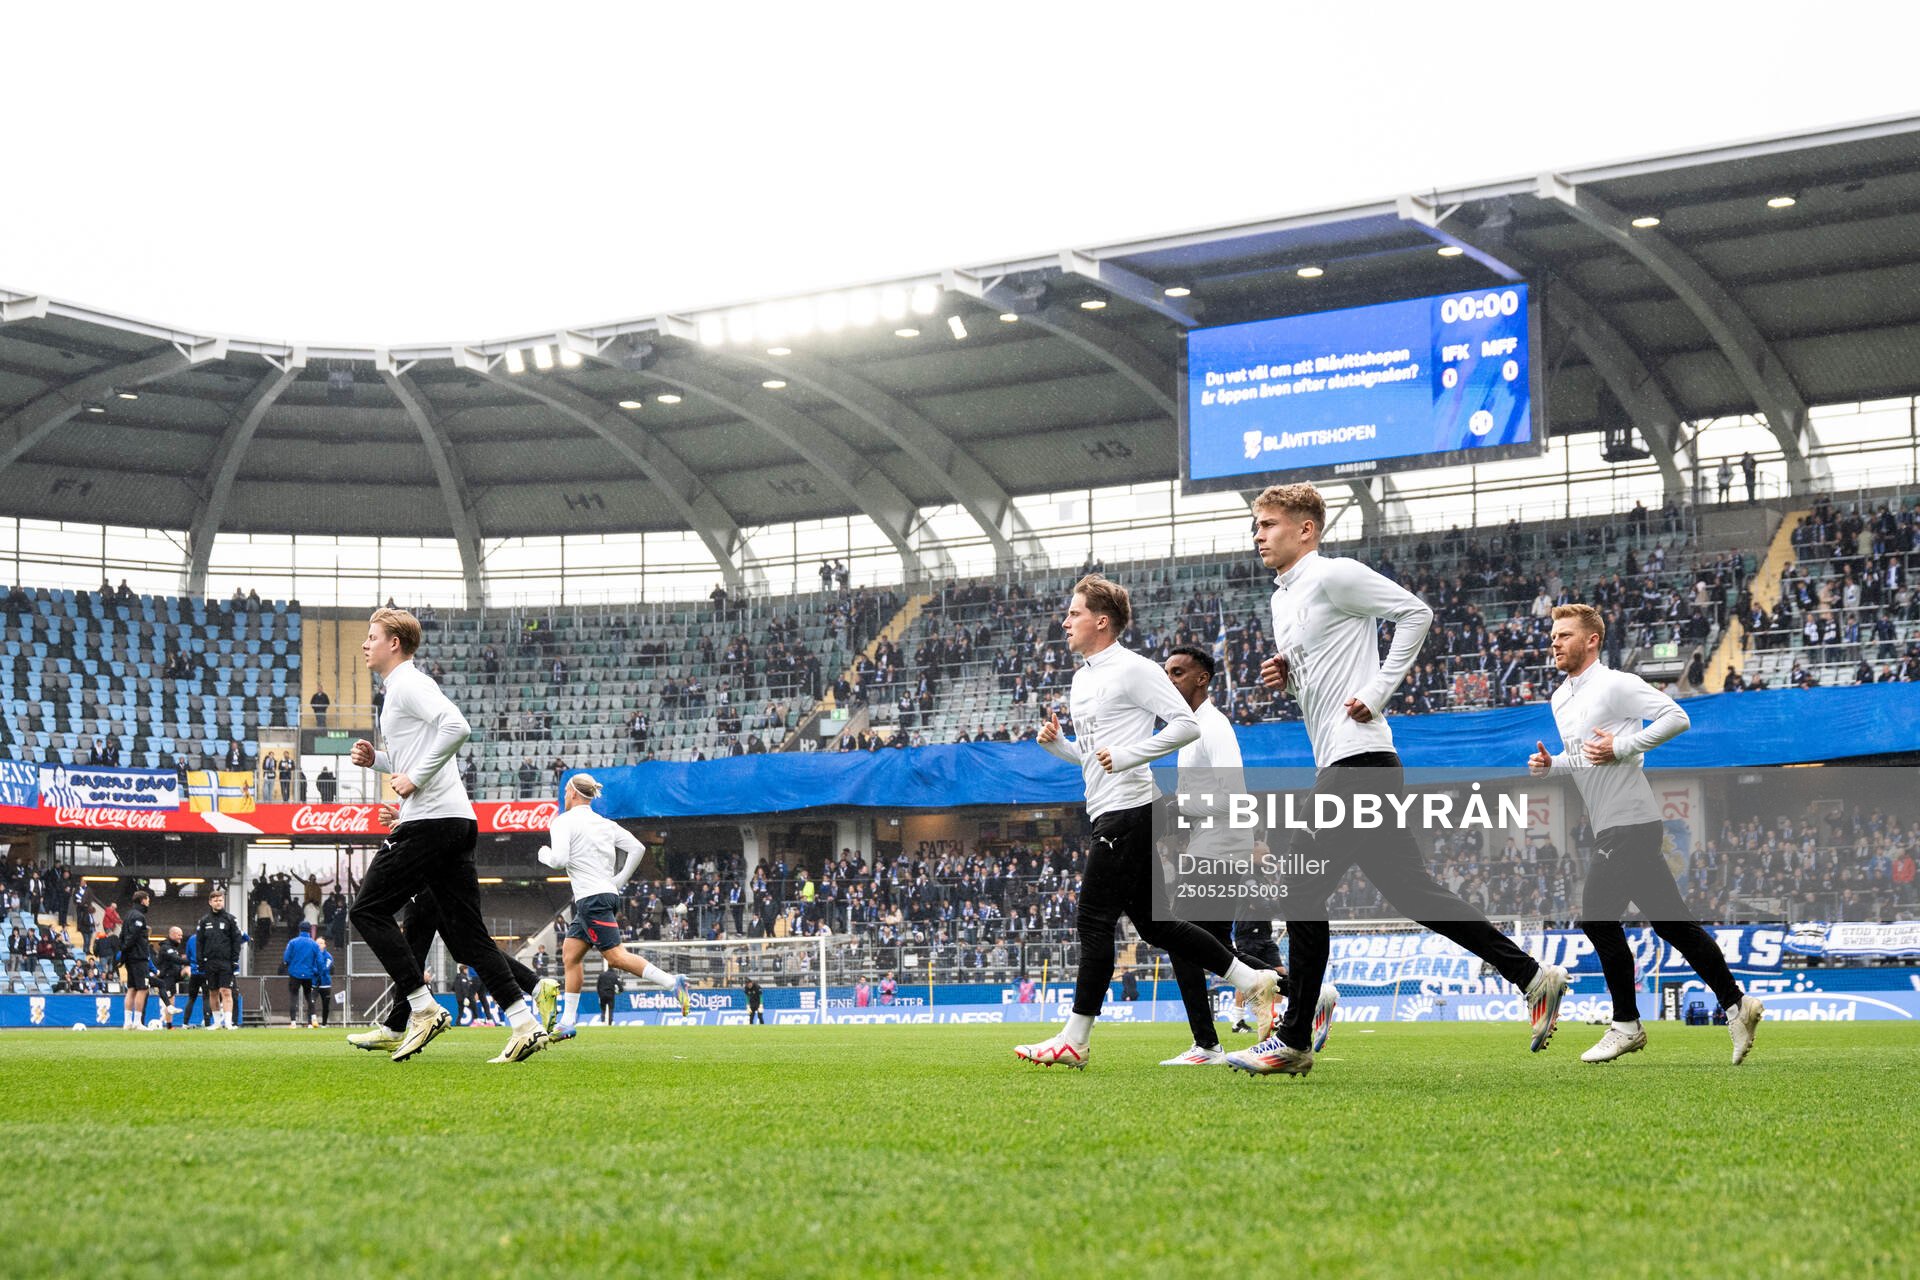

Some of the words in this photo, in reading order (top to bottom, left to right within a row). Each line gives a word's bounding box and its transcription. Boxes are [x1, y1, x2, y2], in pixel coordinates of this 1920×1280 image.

[1441, 290, 1518, 324] 00:00
[1442, 344, 1470, 362] IFK
[1481, 337, 1518, 357] MFF
[1206, 372, 1225, 387] Du
[1225, 370, 1247, 384] vet
[1270, 364, 1291, 378] om
[1293, 359, 1314, 376] att
[1442, 368, 1458, 388] 0
[1502, 360, 1518, 381] 0
[1263, 424, 1377, 451] BLÅVITTSHOPEN
[1334, 461, 1377, 474] SAMSUNG
[292, 804, 372, 833] Coca-Cola
[492, 803, 559, 831] Coca-Col
[1330, 935, 1421, 958] TOBER
[1328, 957, 1470, 981] MRATERNA
